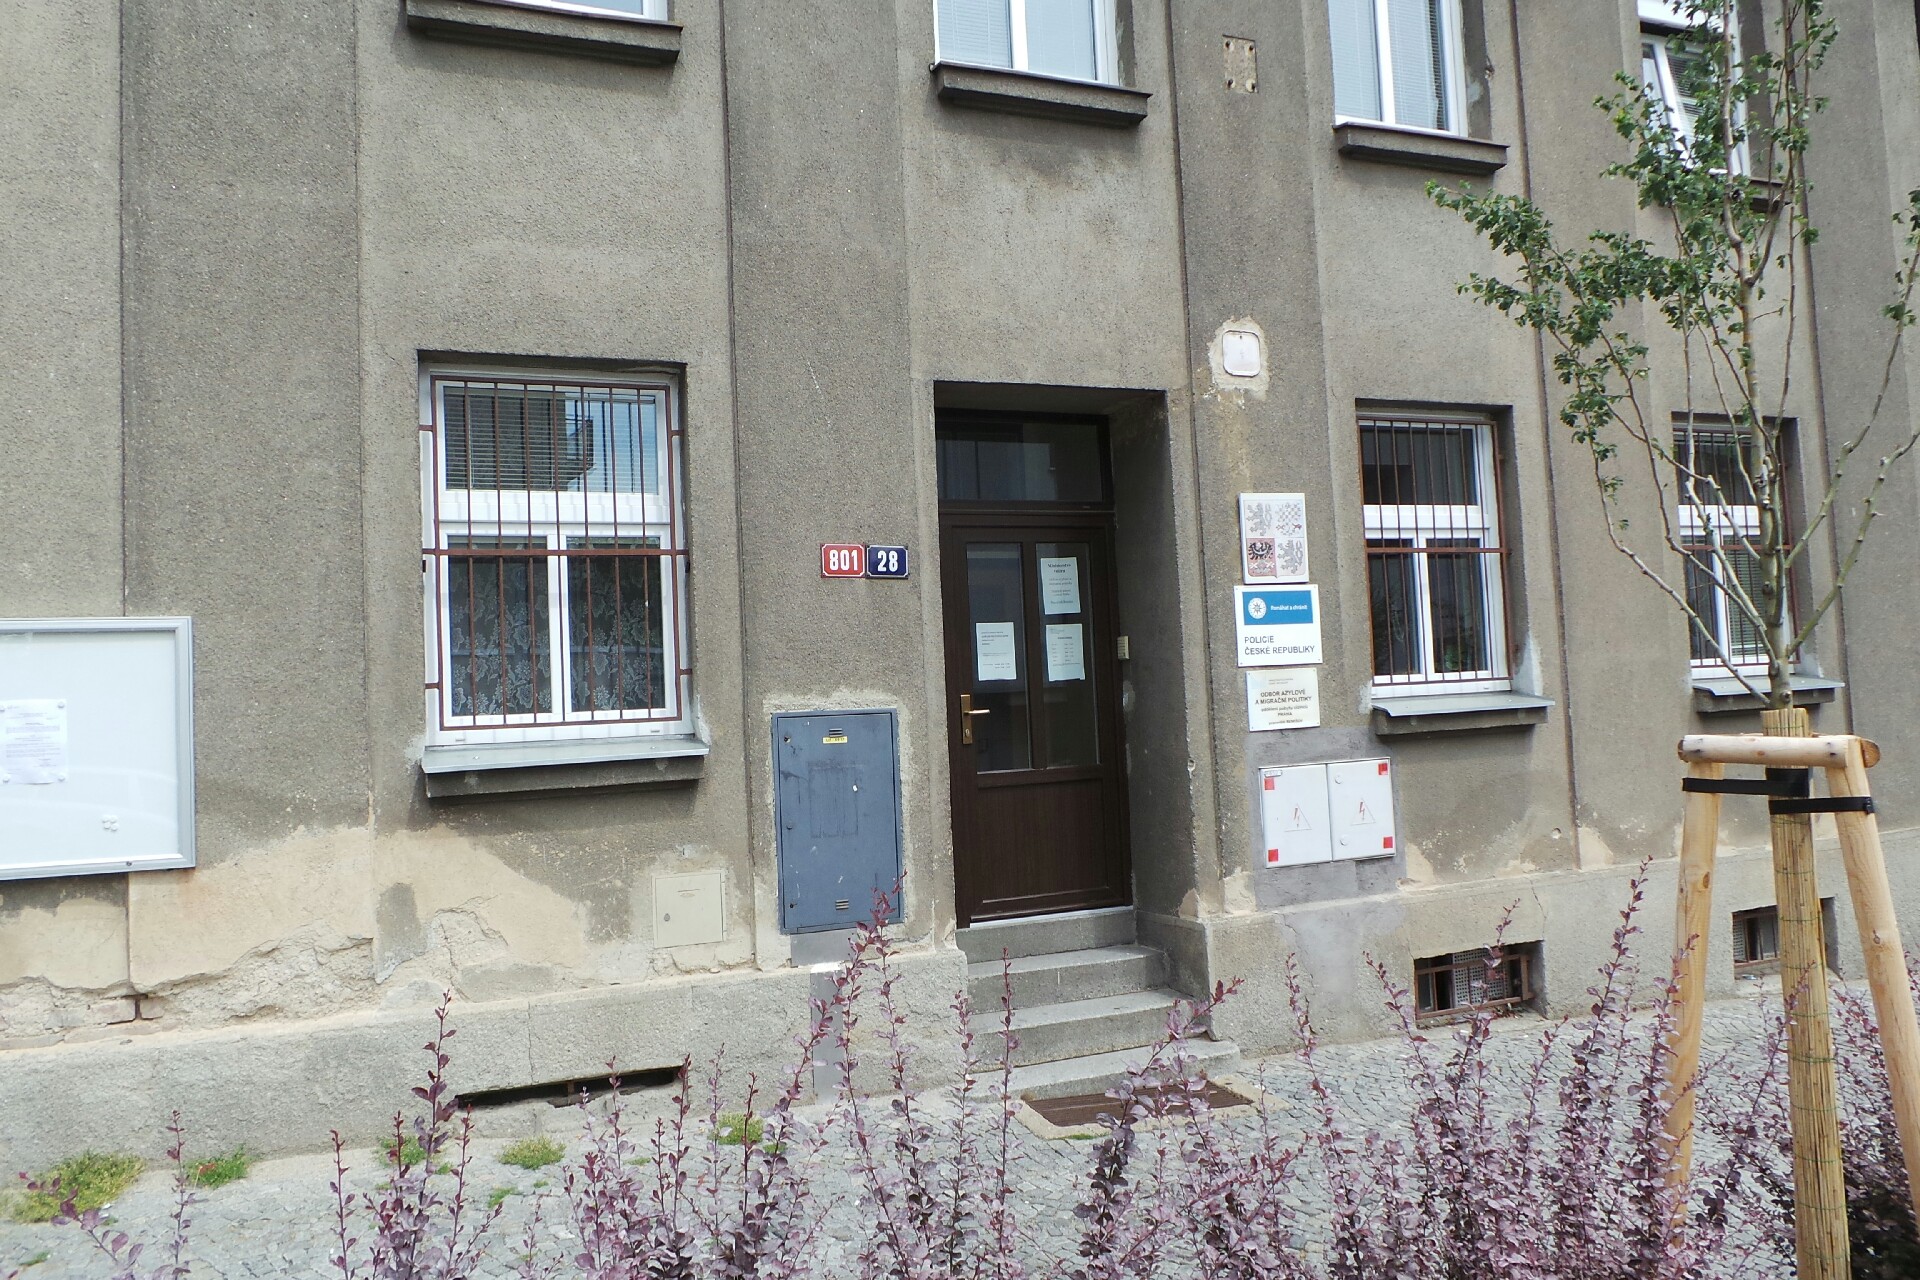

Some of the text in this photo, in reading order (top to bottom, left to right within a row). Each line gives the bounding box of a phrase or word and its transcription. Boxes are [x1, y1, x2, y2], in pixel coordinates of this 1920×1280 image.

[829, 549, 858, 571] 801
[877, 550, 898, 572] 28
[1244, 635, 1274, 644] POLICIE
[1244, 645, 1315, 655] ČESKÉ REPUBLIKY
